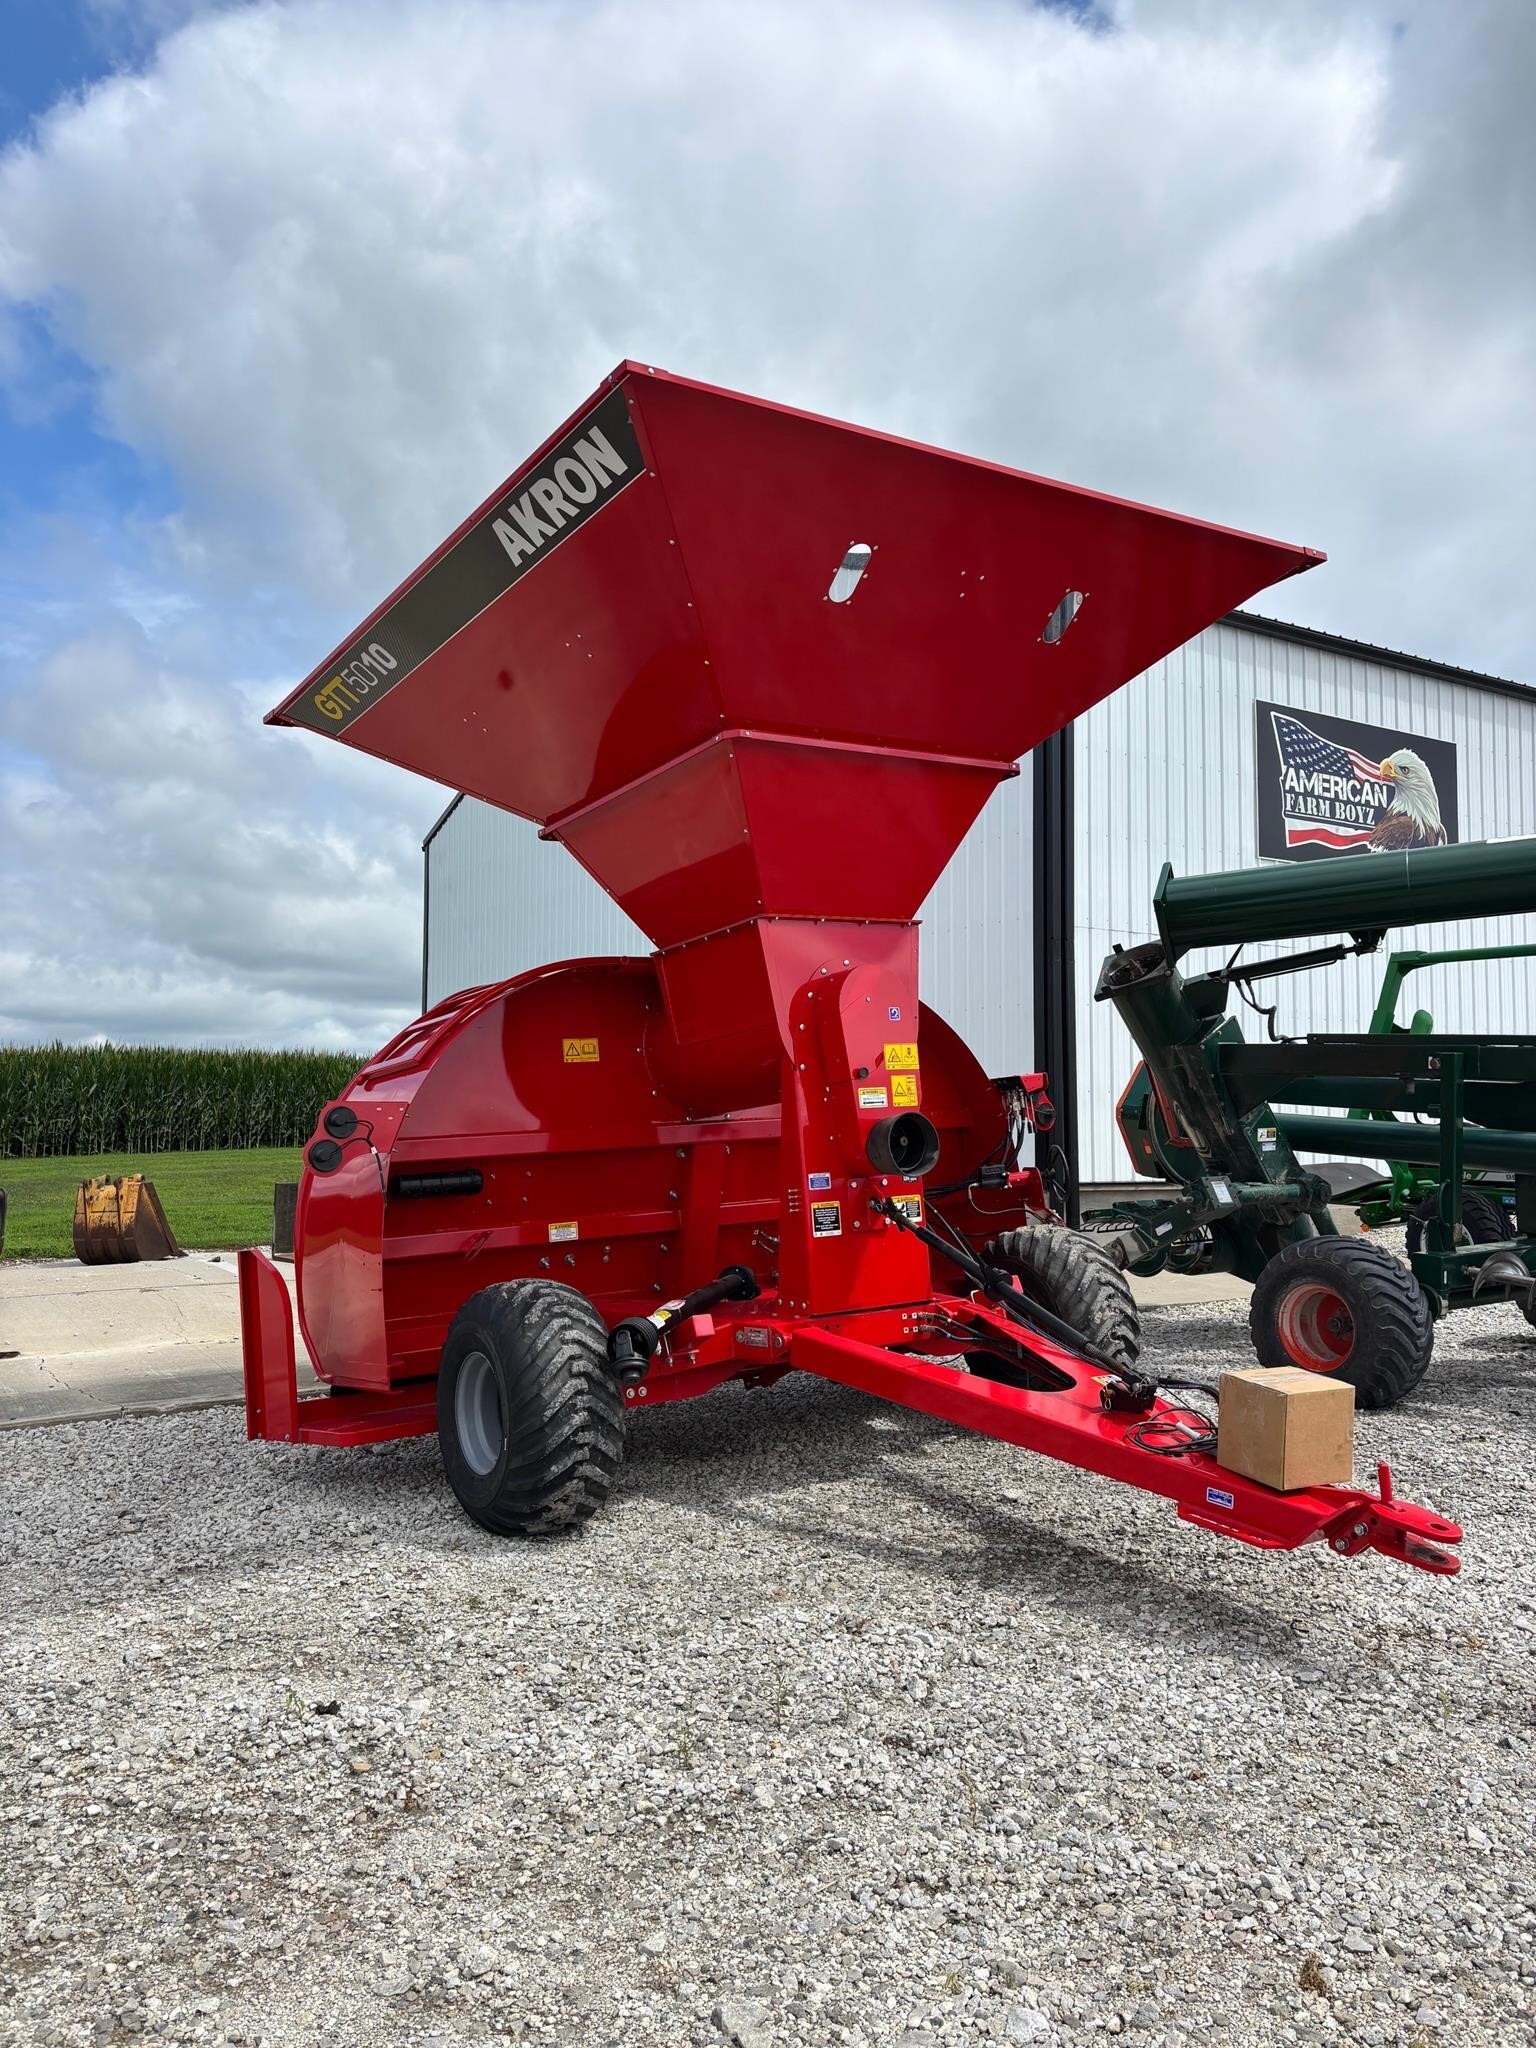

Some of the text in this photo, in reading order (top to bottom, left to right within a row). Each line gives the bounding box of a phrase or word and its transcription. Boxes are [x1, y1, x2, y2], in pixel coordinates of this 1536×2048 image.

[492, 425, 629, 568] AKRON
[314, 643, 398, 720] GTT5010
[1285, 767, 1388, 808] AMERICAN
[1285, 793, 1376, 825] FARM BOYZ
